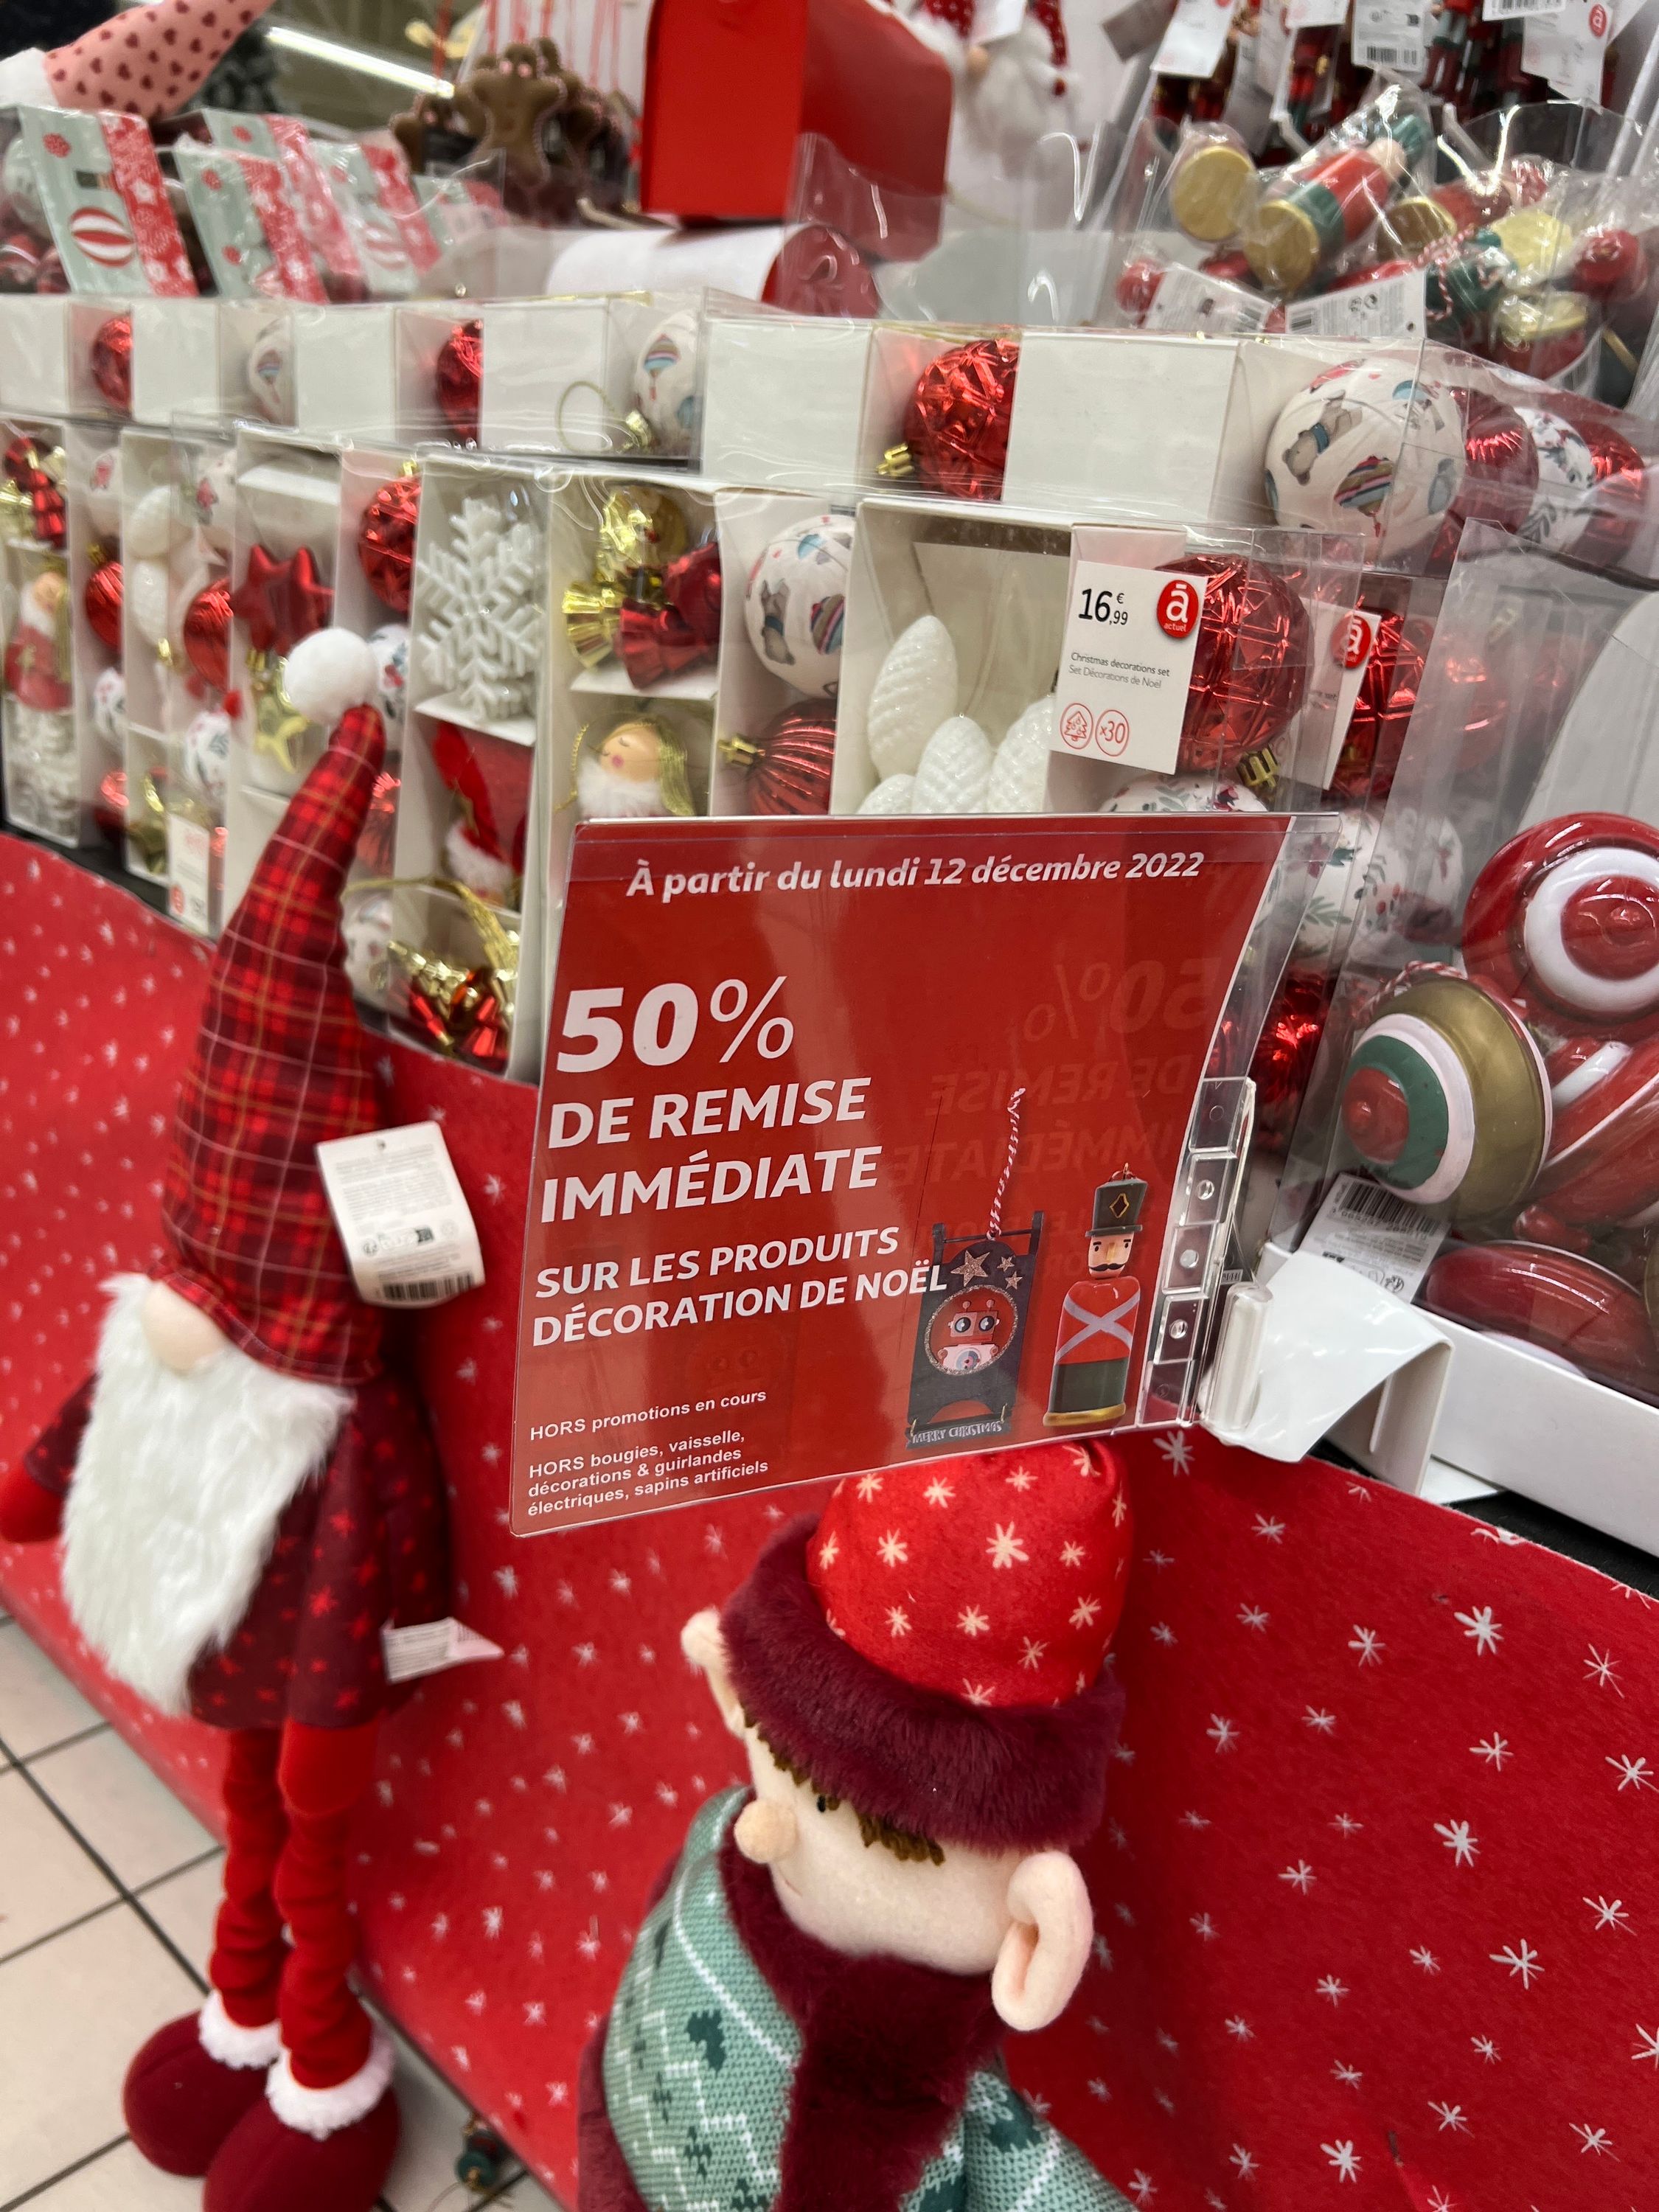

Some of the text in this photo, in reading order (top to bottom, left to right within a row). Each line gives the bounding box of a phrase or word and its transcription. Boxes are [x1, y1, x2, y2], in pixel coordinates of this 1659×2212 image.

[1164, 622, 1186, 633] actuel
[1068, 664, 1082, 675] Set
[1083, 667, 1129, 684] Décorations
[1130, 675, 1141, 685] de
[1071, 652, 1170, 677] Christmas decorations set
[1100, 720, 1127, 745] x30
[625, 851, 1205, 904] À partir du lundi 12 décembre 2022
[556, 975, 795, 1074] 50%
[548, 1077, 872, 1150] DE REMISE
[540, 1145, 883, 1223] IMMÉDIATE
[535, 1226, 900, 1299] SUR LES PRODUITS
[532, 1259, 949, 1347] DÉCORATION DE NOËL
[529, 1390, 767, 1441] HORS promotions en cours
[912, 1420, 1003, 1444] MERRY CHRISTMAS
[527, 1447, 742, 1498] décorations & guirlandes
[529, 1429, 745, 1478] HORS bougies, vaisselle,
[527, 1460, 769, 1517] électriques, sapins artificiels
